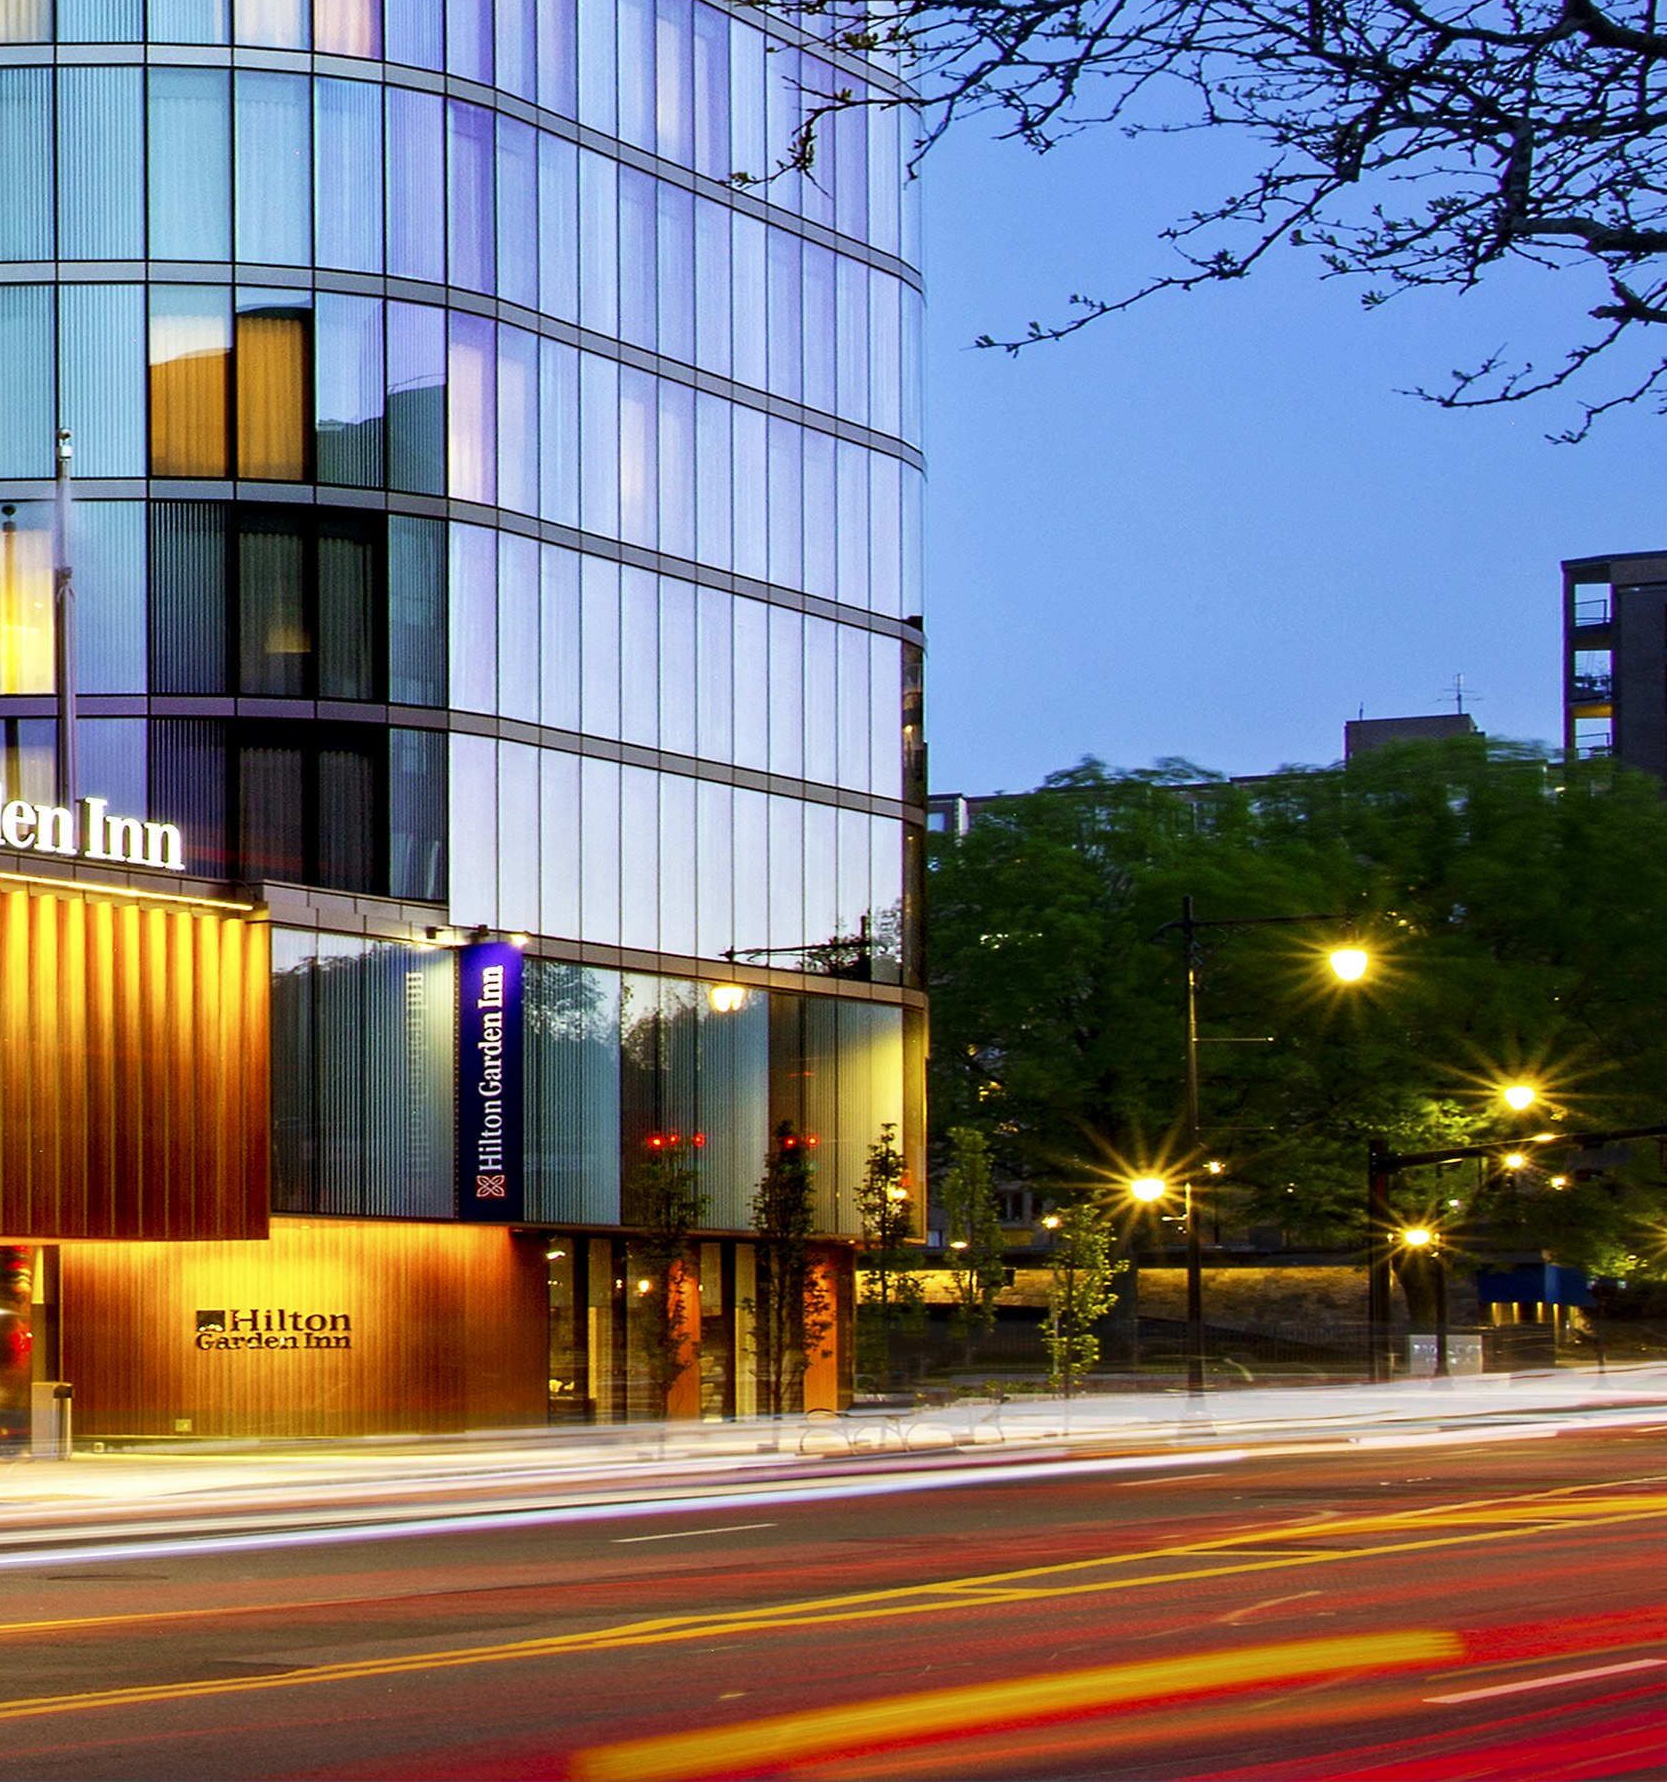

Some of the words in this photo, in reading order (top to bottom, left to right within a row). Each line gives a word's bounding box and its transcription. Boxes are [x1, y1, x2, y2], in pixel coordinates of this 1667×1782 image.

[80, 795, 185, 871] Inn
[478, 964, 504, 1010] Inn
[478, 1011, 503, 1097] Garden
[478, 1099, 503, 1171] Hilton
[196, 1332, 299, 1350] Garden
[303, 1332, 351, 1349] Inn
[230, 1309, 351, 1332] Hilton
